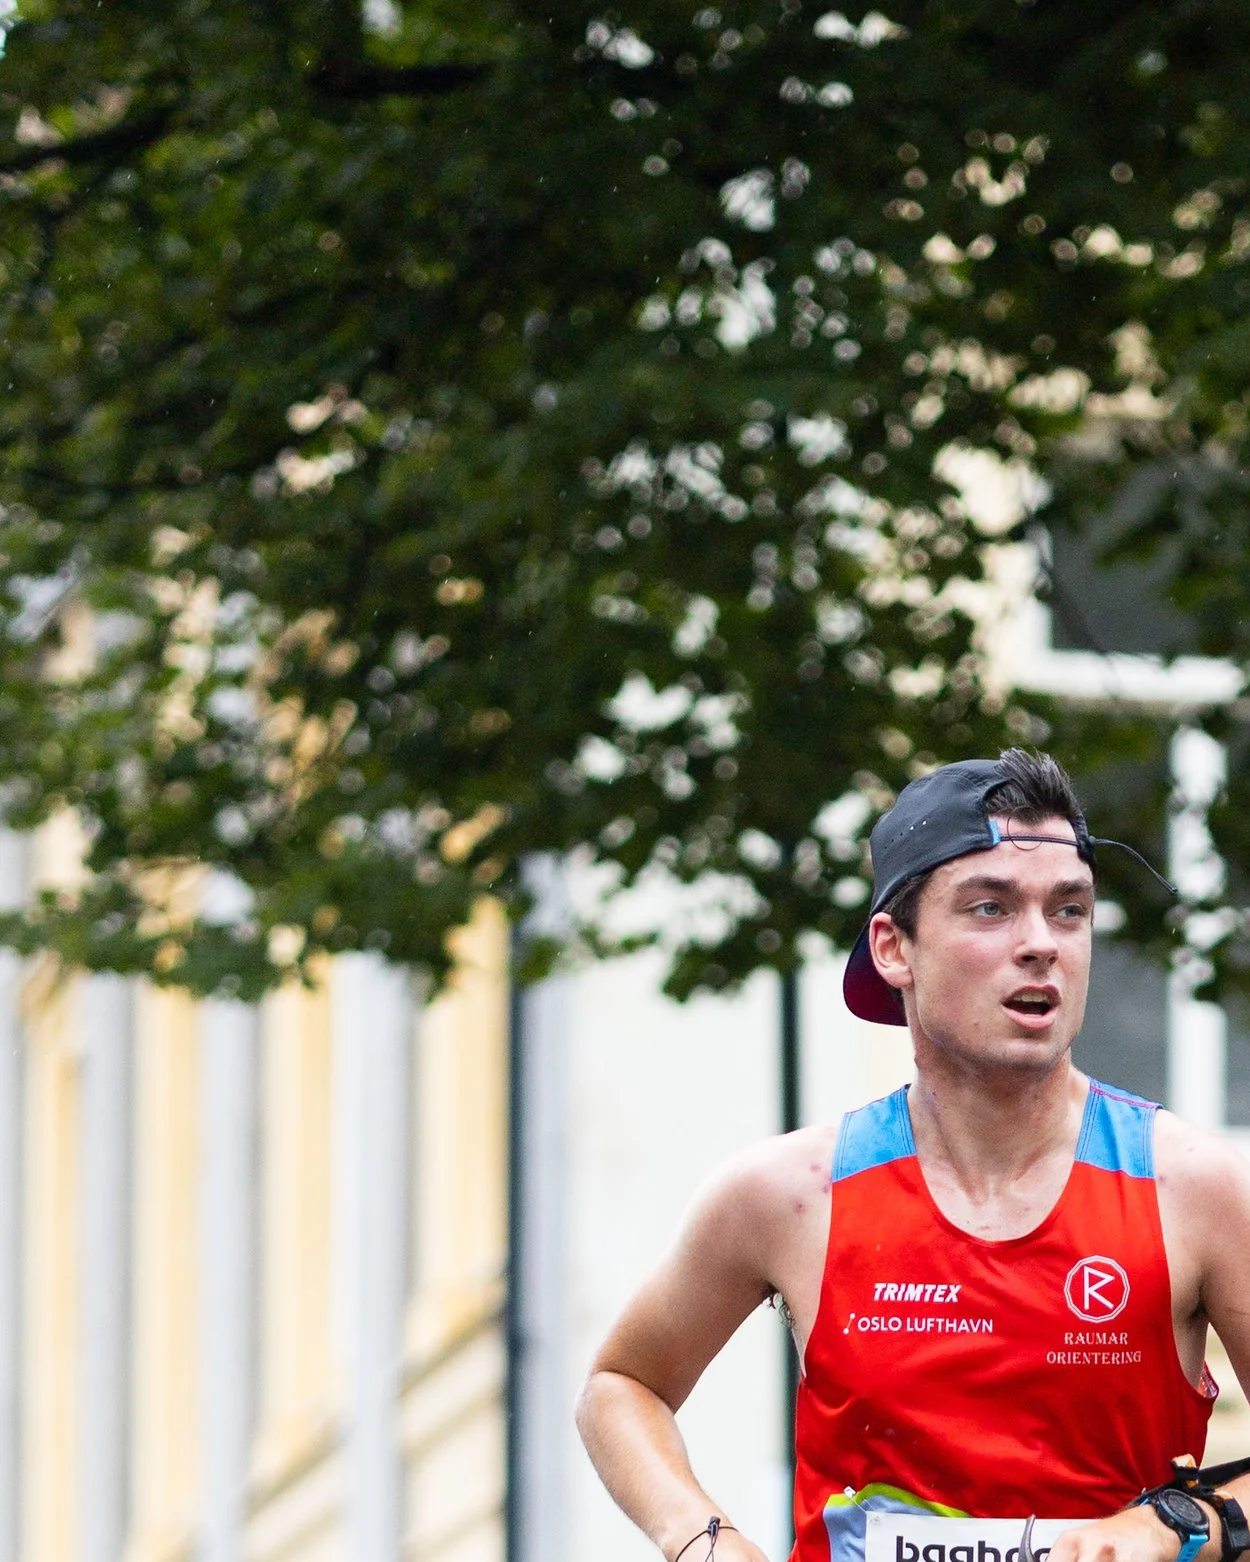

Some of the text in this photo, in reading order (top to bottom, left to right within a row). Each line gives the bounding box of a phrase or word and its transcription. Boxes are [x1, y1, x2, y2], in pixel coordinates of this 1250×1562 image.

[873, 1282, 962, 1303] TRIMTEX
[857, 1316, 994, 1333] OSLO LUFTHAVN
[1064, 1331, 1128, 1346] RAUMAR
[1046, 1350, 1142, 1365] ORIENTERING
